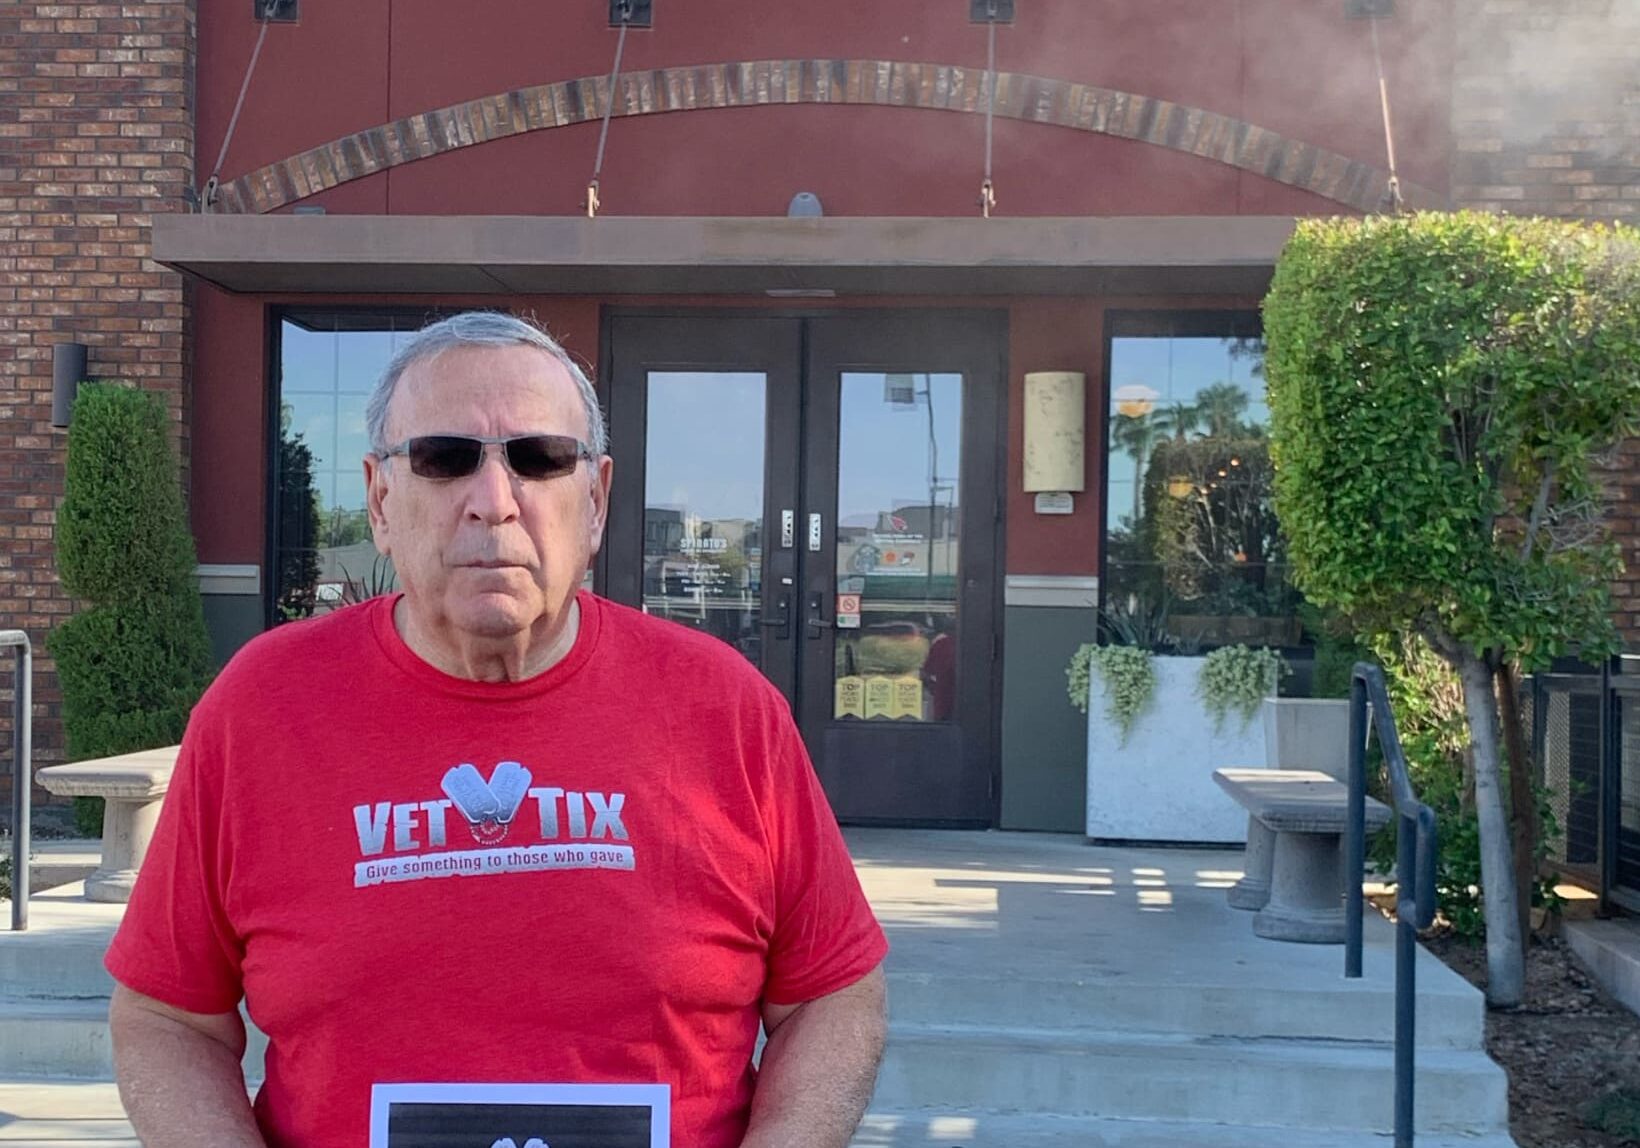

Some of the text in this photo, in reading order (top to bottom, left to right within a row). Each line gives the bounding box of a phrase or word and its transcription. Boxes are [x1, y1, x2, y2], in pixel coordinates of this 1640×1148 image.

[353, 787, 629, 856] VET TIX
[366, 849, 624, 879] Give something to those who gave
